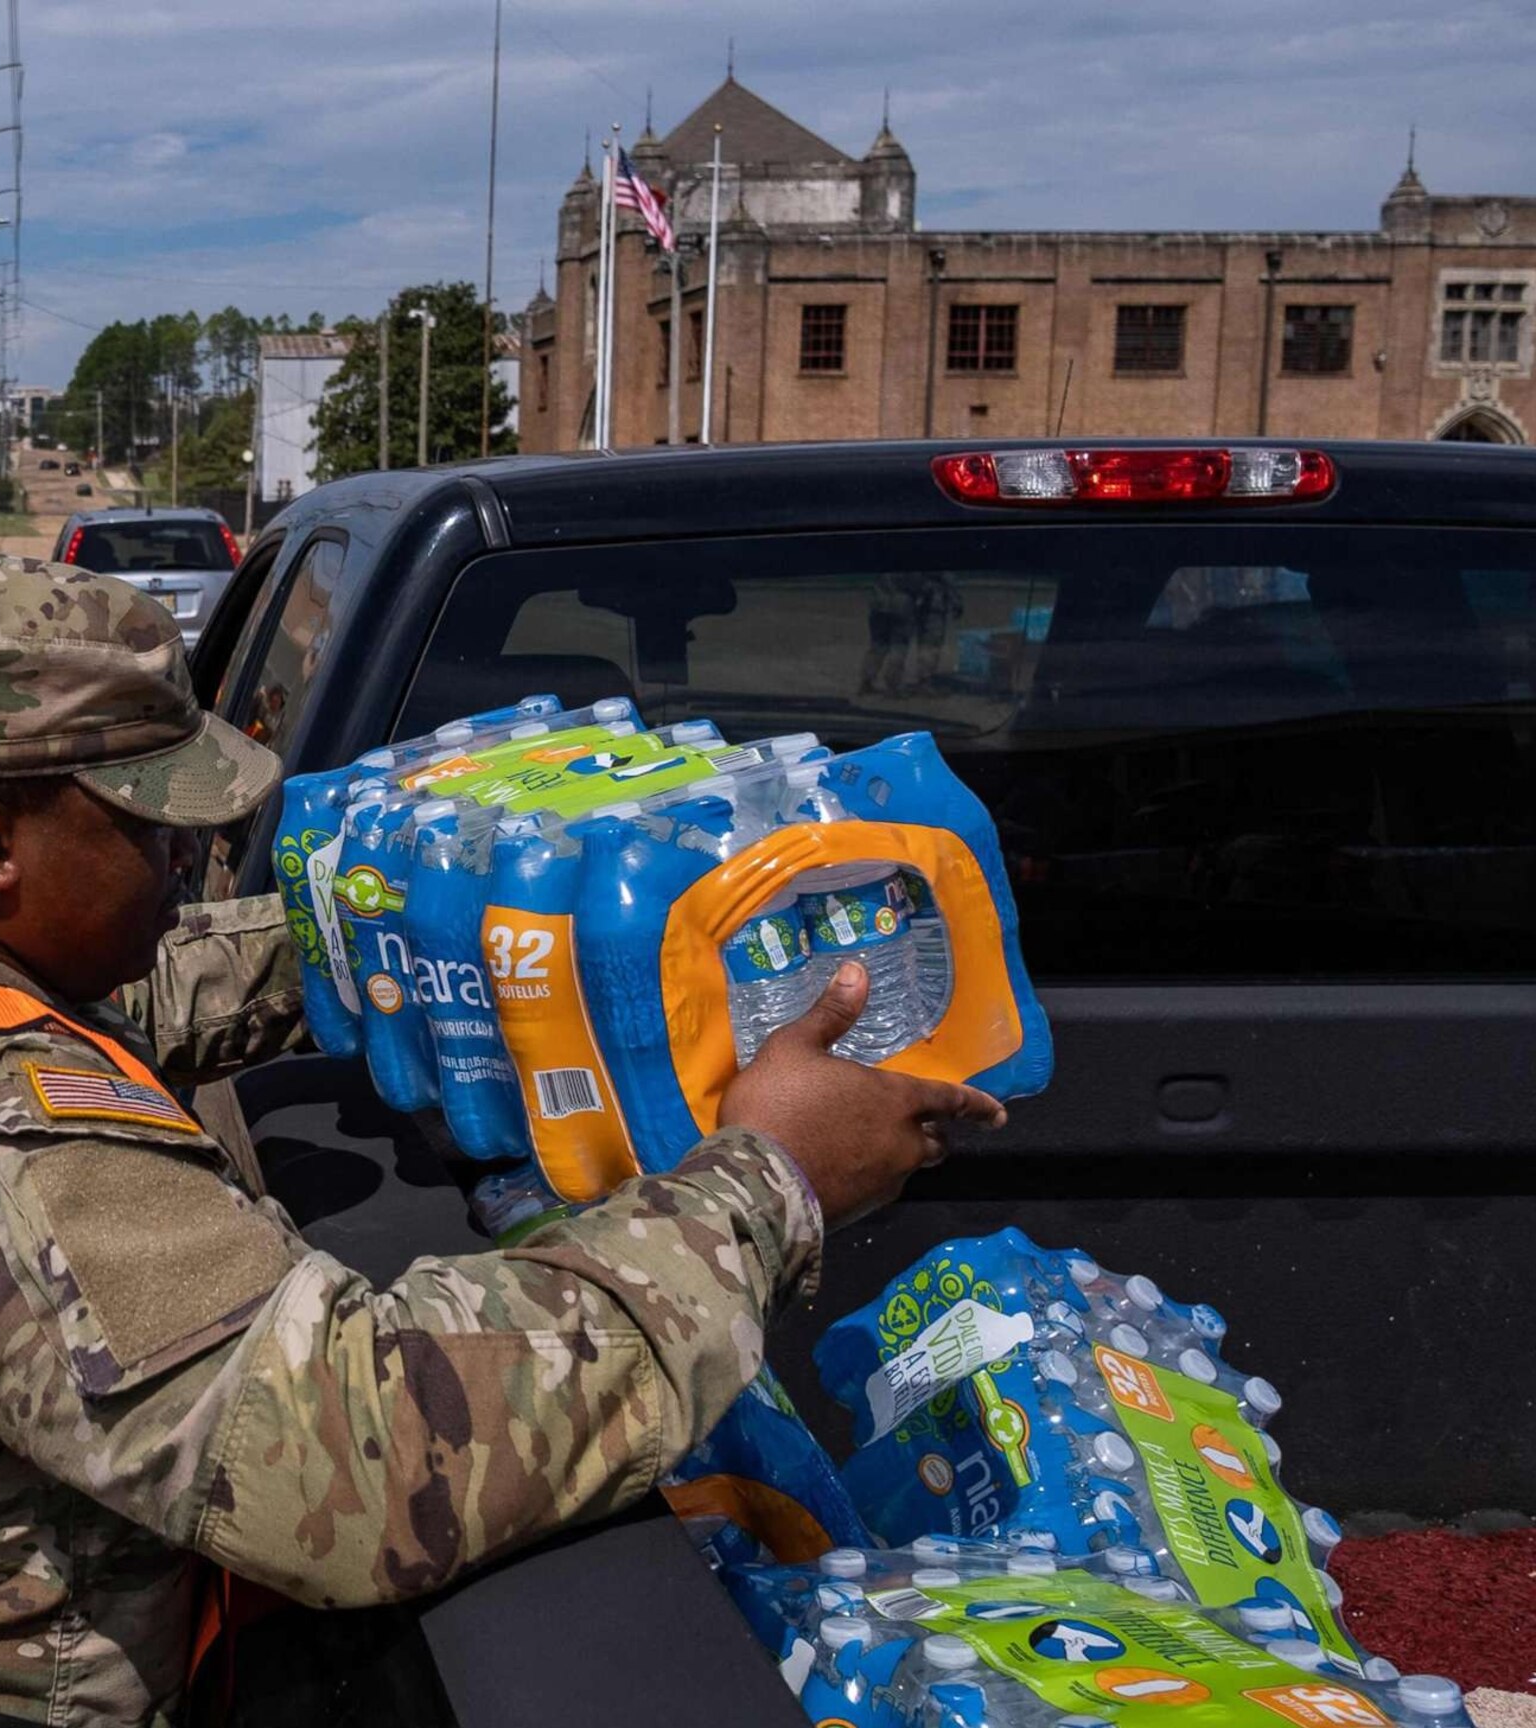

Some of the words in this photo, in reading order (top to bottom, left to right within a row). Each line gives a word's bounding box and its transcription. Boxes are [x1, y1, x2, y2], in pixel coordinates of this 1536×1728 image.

[488, 925, 555, 979] 32
[498, 984, 552, 999] BOTELLAS
[903, 1351, 926, 1370] A
[1101, 1353, 1150, 1407] 32
[1138, 1440, 1173, 1460] A
[1147, 1457, 1188, 1514] MAKE
[1164, 1513, 1210, 1567] LET'S
[1174, 1458, 1240, 1570] DIFFERENCE
[1290, 1687, 1386, 1726] 32
